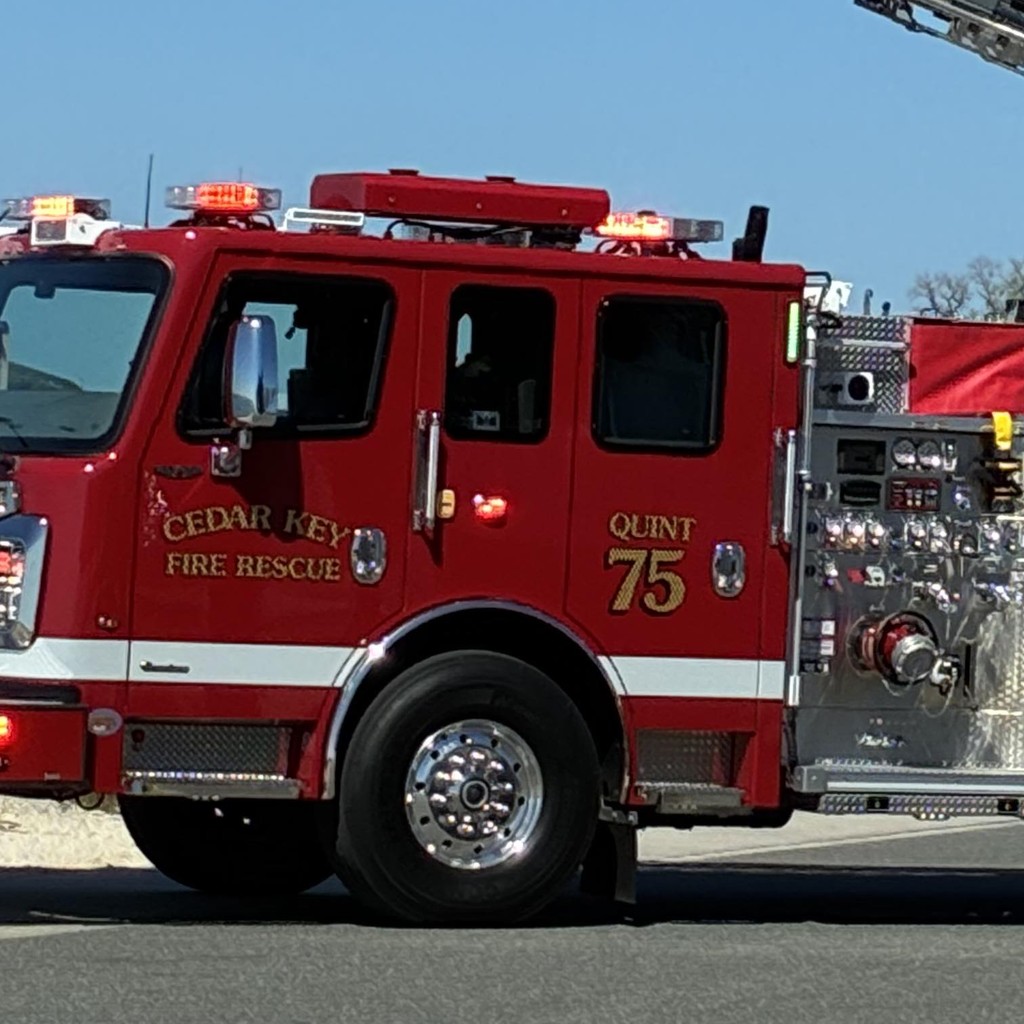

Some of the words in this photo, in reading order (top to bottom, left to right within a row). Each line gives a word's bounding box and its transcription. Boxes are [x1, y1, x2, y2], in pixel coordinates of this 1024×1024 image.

[162, 505, 271, 542] CEDAR
[283, 509, 351, 549] KEY
[609, 512, 697, 541] QUINT
[166, 552, 228, 576] FIRE
[235, 554, 341, 580] RESCUE
[607, 547, 686, 613] 75
